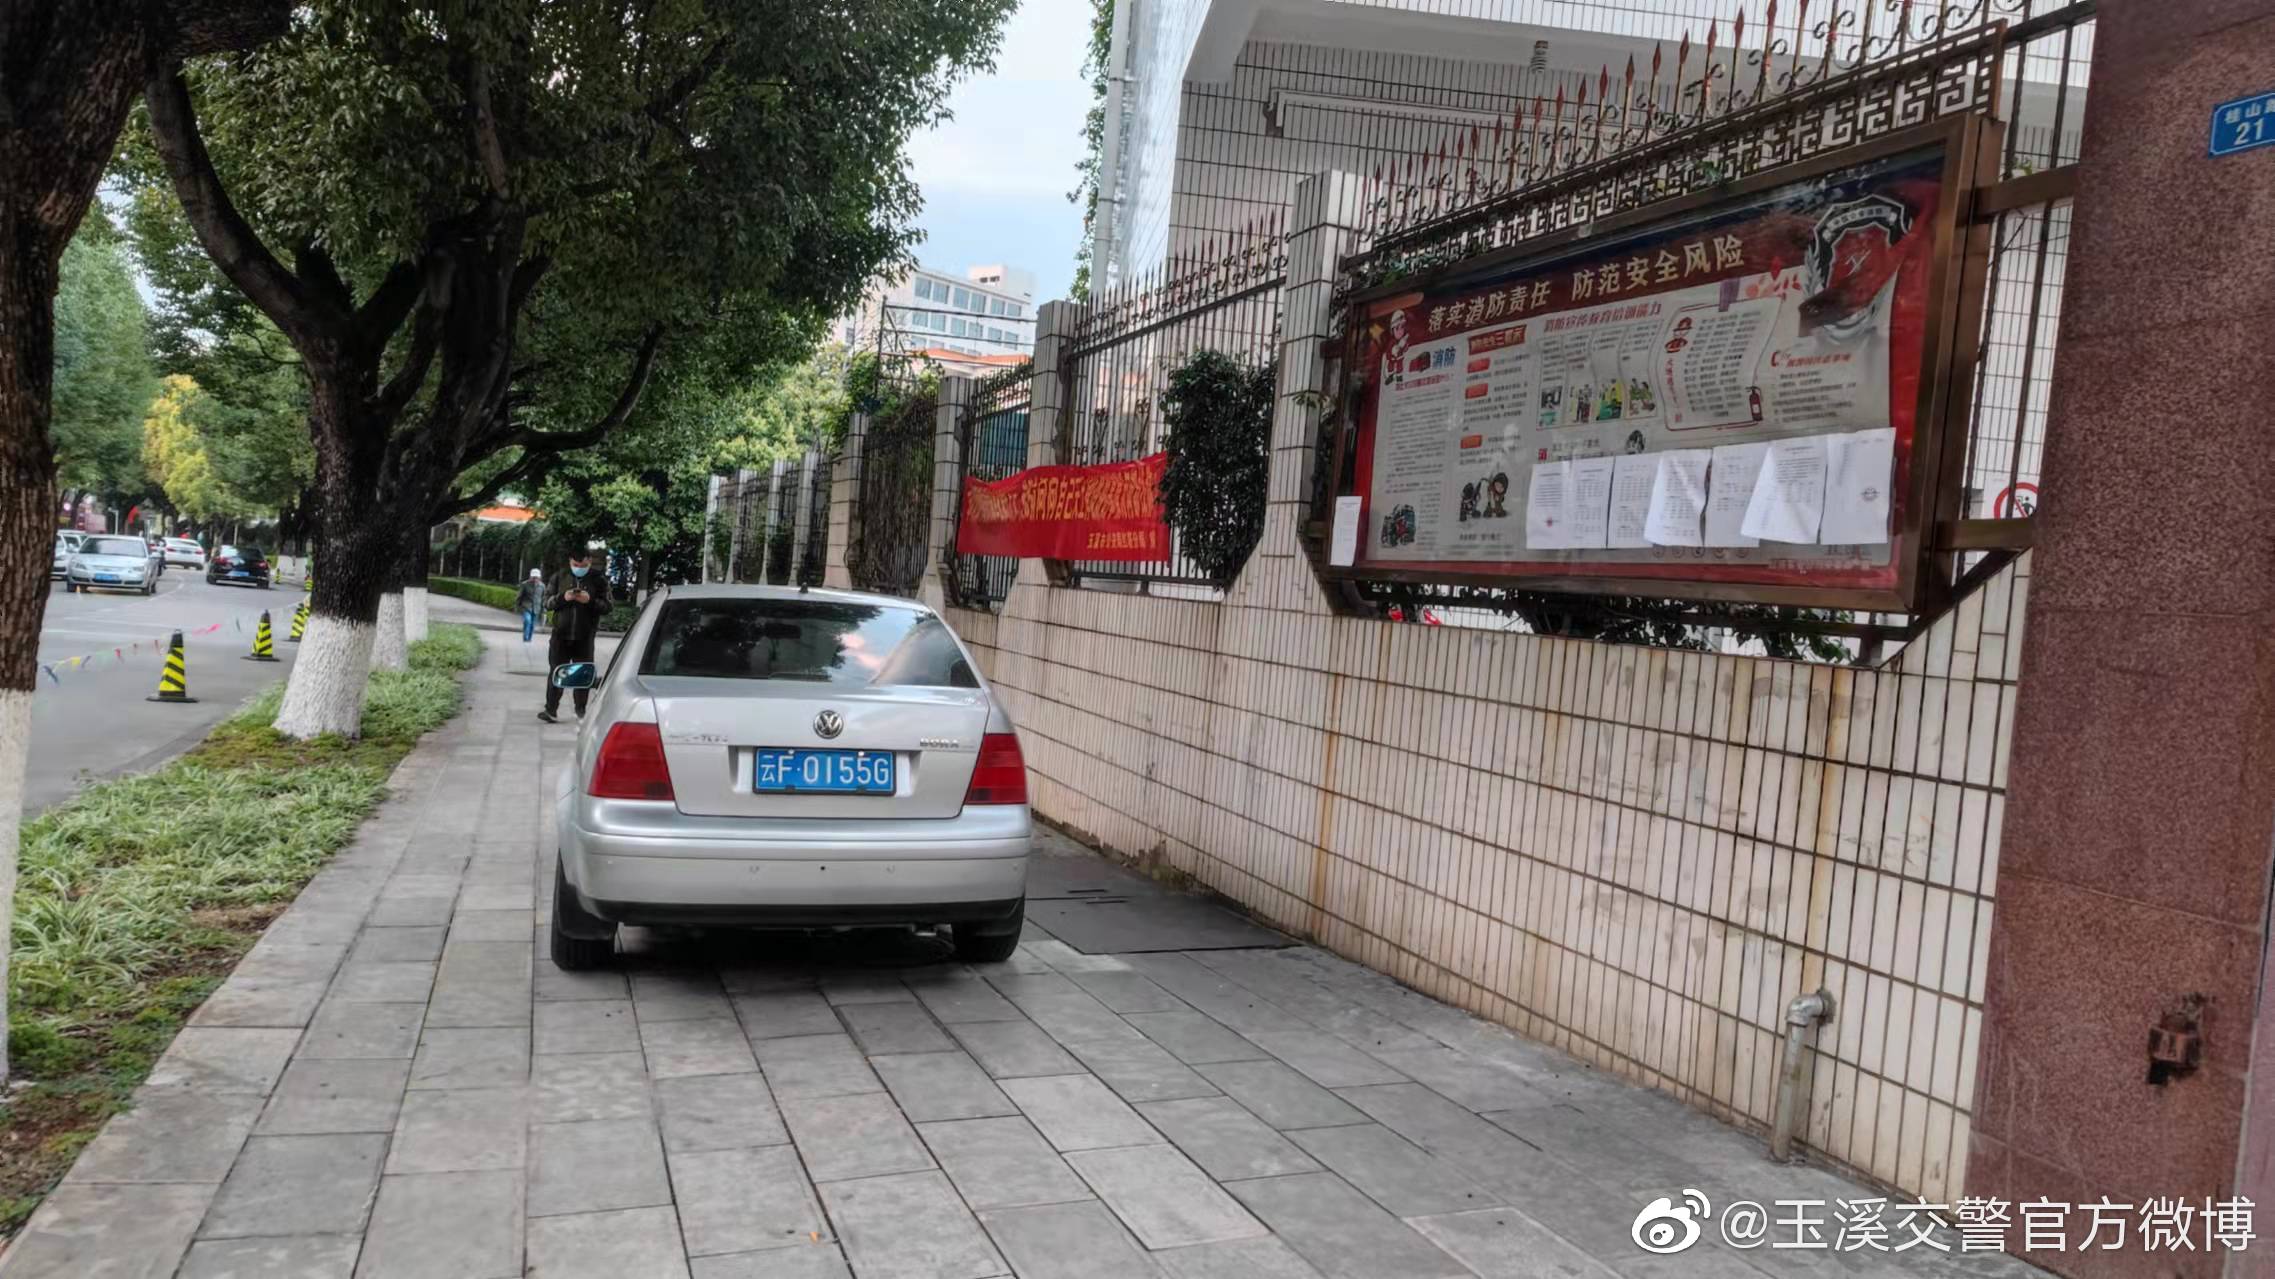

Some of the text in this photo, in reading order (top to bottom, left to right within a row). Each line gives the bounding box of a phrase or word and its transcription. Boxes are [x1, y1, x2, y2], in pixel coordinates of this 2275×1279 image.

[2234, 118, 2264, 146] 21
[1428, 234, 1745, 333] 落实消防责任 防范安全风险
[1431, 346, 1456, 369] 消防
